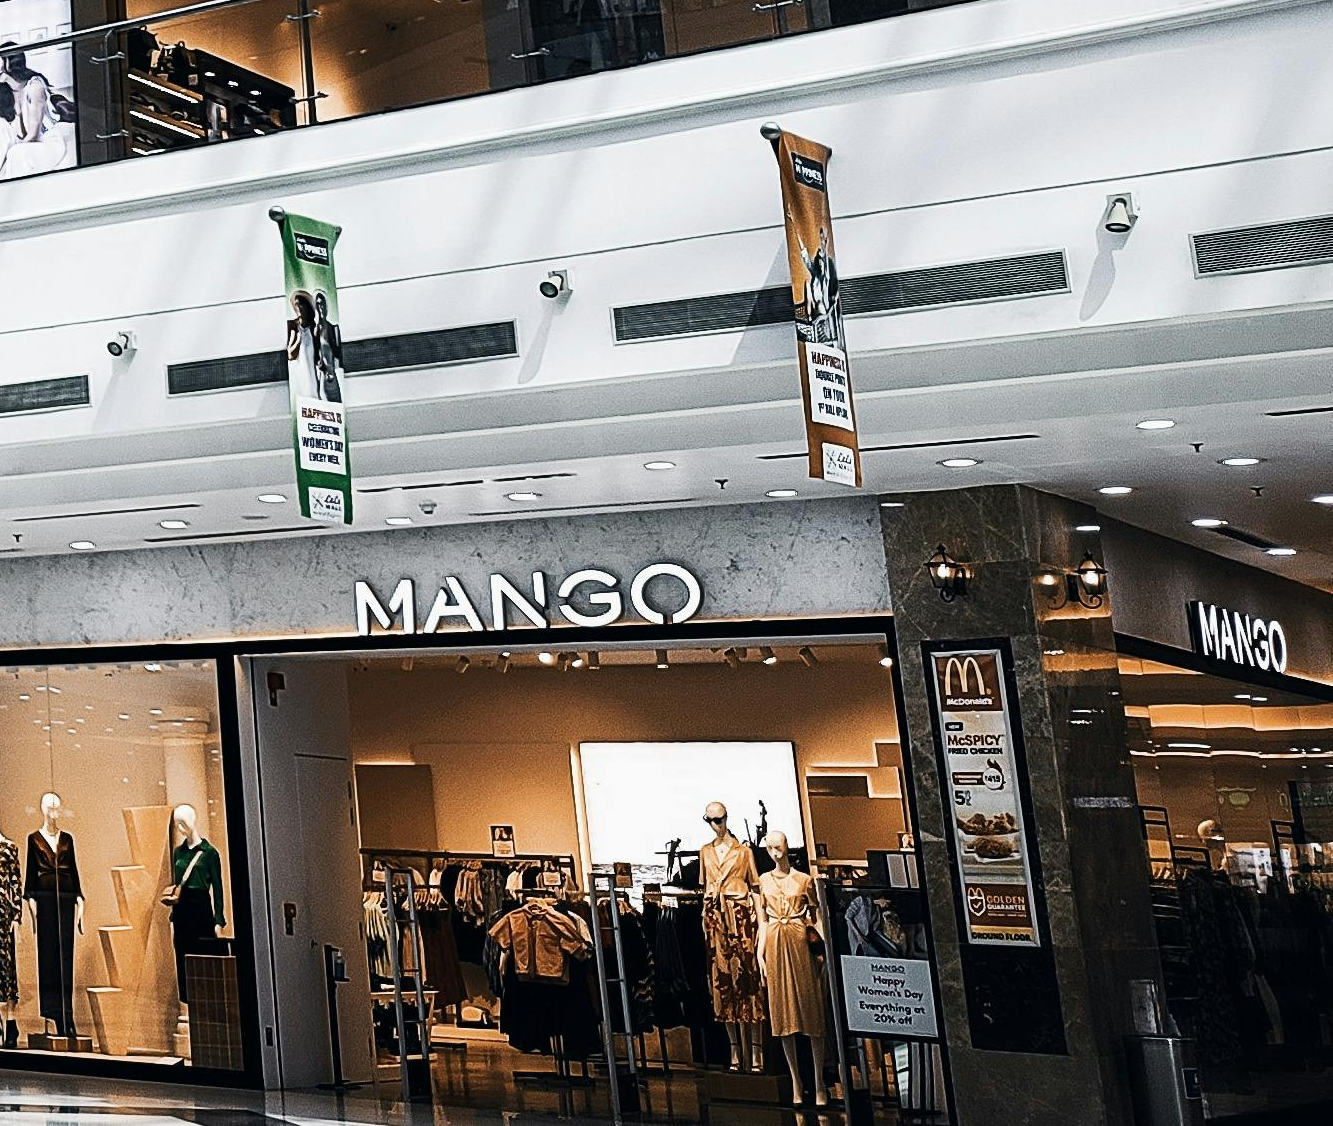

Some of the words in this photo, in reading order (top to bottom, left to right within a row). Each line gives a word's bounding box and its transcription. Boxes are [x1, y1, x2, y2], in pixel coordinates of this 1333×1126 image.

[301, 436, 334, 450] WOMEN'S
[354, 562, 701, 636] MANGO
[1198, 601, 1287, 674] MANGO
[947, 734, 1002, 746] McSPICY
[986, 895, 1026, 905] GOLDEN
[986, 903, 1027, 912] GUARANTEE
[972, 933, 1005, 941] GROUND
[870, 963, 906, 974] MANGO
[873, 975, 906, 988] Happy
[857, 985, 902, 998] Women's
[904, 989, 924, 1001] Day
[859, 1001, 912, 1016] Everything
[913, 1006, 926, 1015] at
[874, 1014, 896, 1024] 20%
[897, 1016, 913, 1025] off
